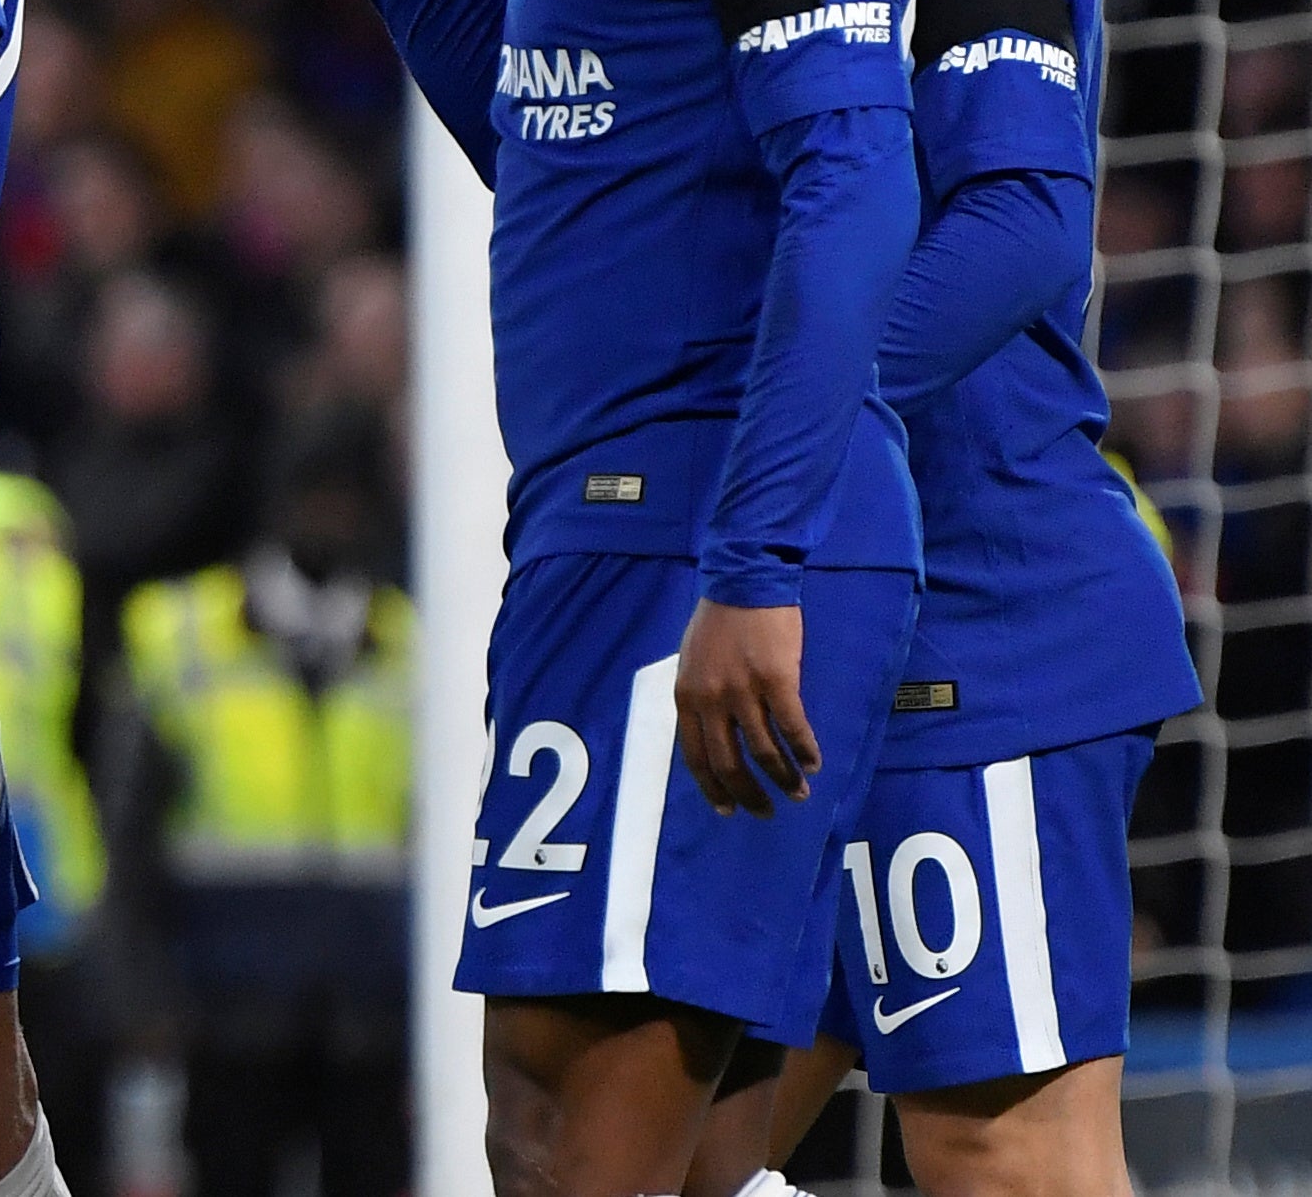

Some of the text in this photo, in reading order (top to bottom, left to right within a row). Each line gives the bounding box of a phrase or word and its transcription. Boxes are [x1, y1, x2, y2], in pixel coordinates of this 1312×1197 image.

[761, 1, 892, 53] ALLIANCE
[844, 27, 891, 44] TYRES
[962, 36, 1077, 78] ALLIANCE
[1040, 65, 1076, 91] TYRES
[522, 100, 616, 141] TYRES
[843, 831, 982, 985] 10
